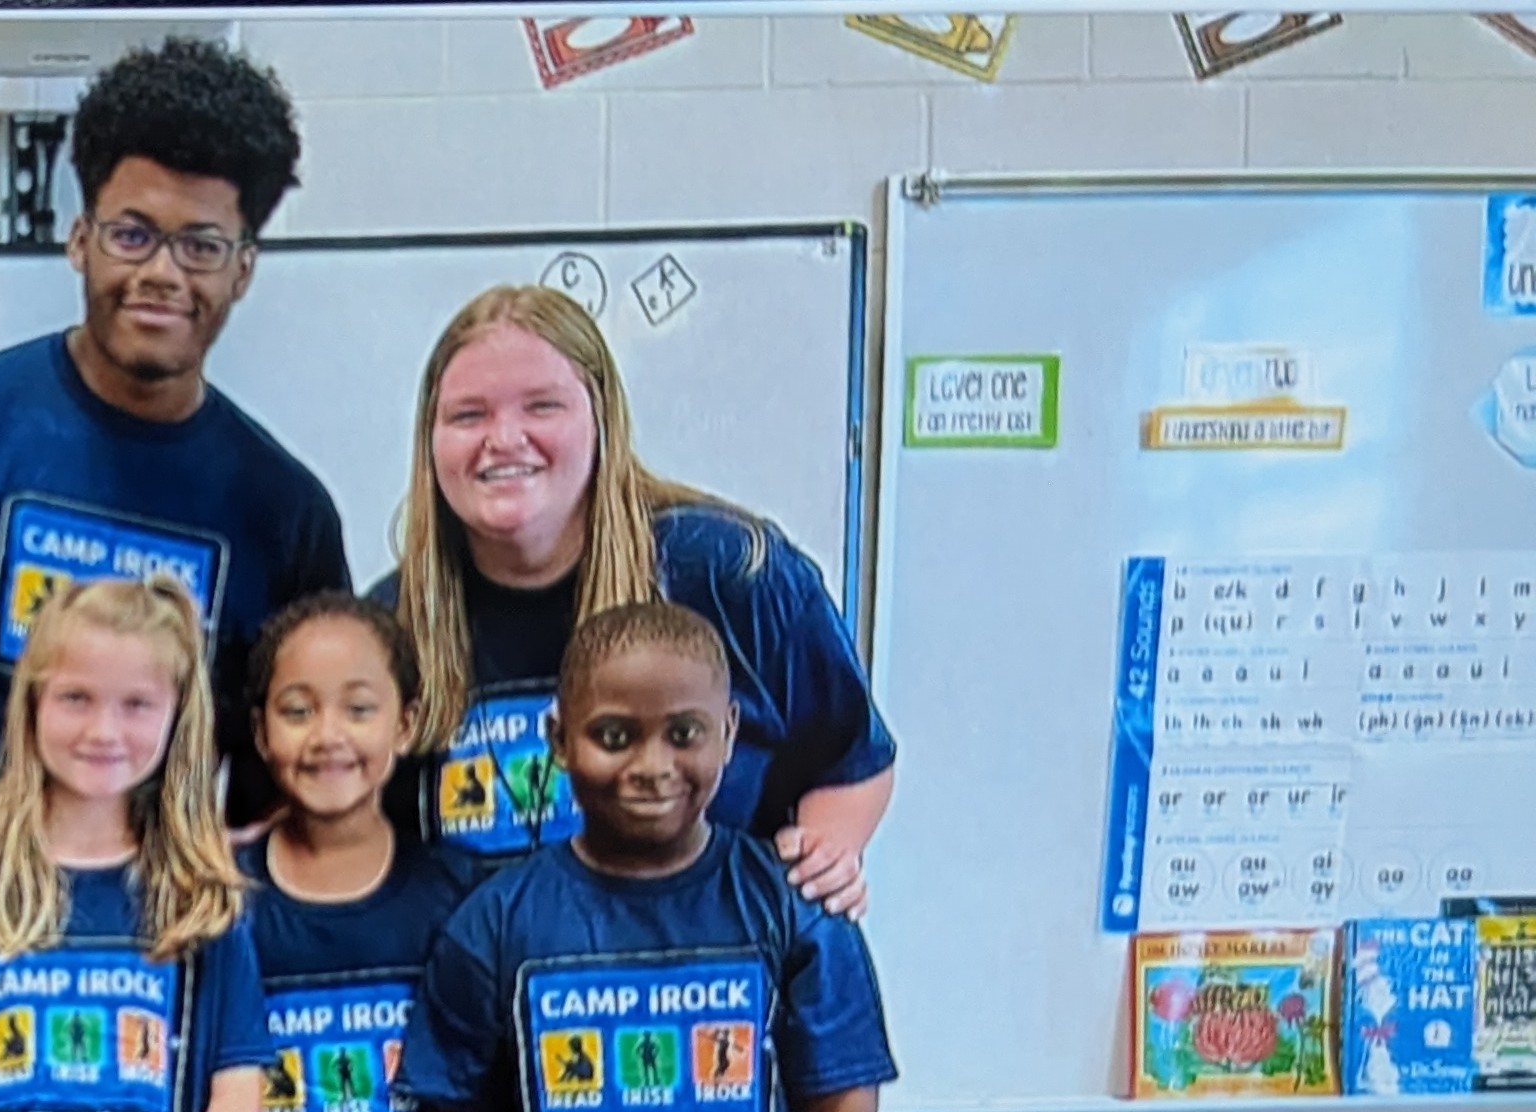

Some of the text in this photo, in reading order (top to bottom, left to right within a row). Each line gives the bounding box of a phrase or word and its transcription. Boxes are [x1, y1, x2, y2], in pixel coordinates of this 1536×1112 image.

[22, 524, 109, 567] CAMP
[1390, 613, 1403, 629] v
[1429, 612, 1448, 628] w
[1475, 613, 1487, 628] x
[1514, 612, 1526, 632] y
[1410, 922, 1468, 949] CAT
[539, 984, 640, 1019] CAMP
[1408, 984, 1470, 1011] HAT
[267, 1004, 334, 1037] AMP
